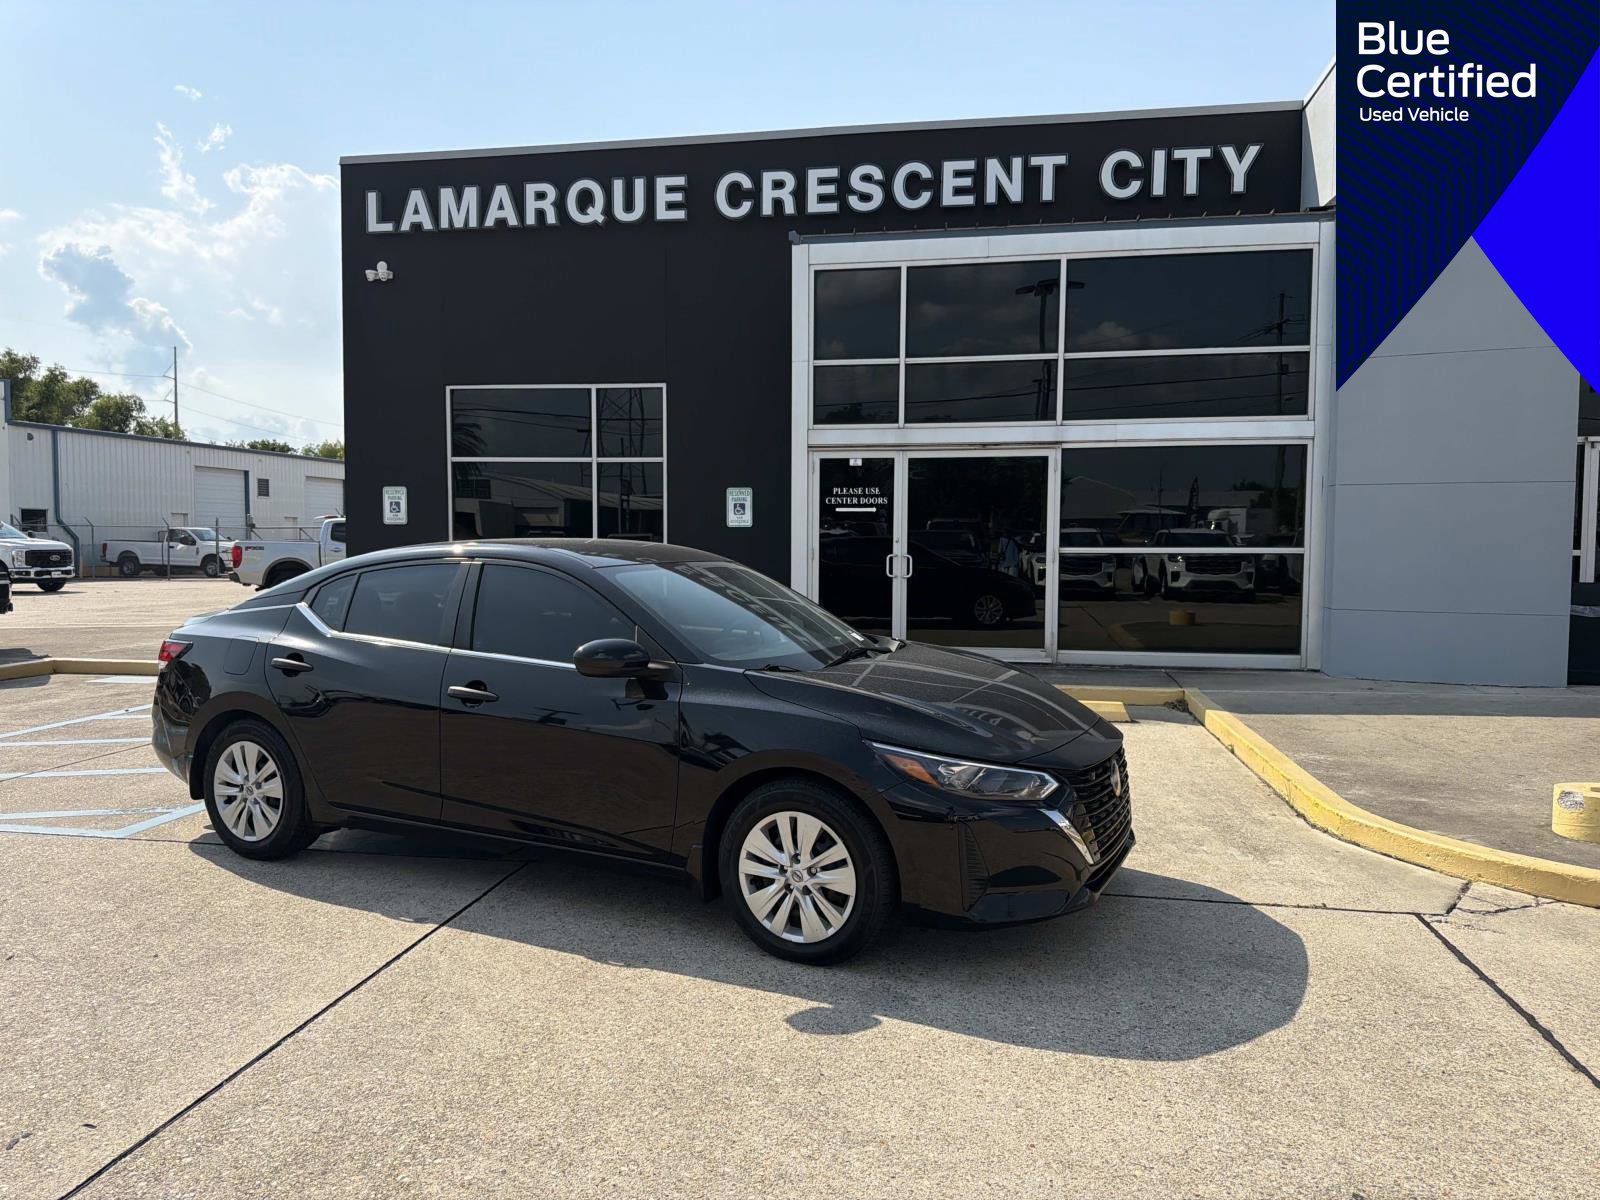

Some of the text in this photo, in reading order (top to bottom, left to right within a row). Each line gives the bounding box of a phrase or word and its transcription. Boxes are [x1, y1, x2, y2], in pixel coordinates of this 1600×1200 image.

[366, 144, 1262, 233] LAMARQUE CRESCENT CITY
[832, 487, 881, 495] PLEASE USE
[825, 496, 888, 505] CENTER DOORS
